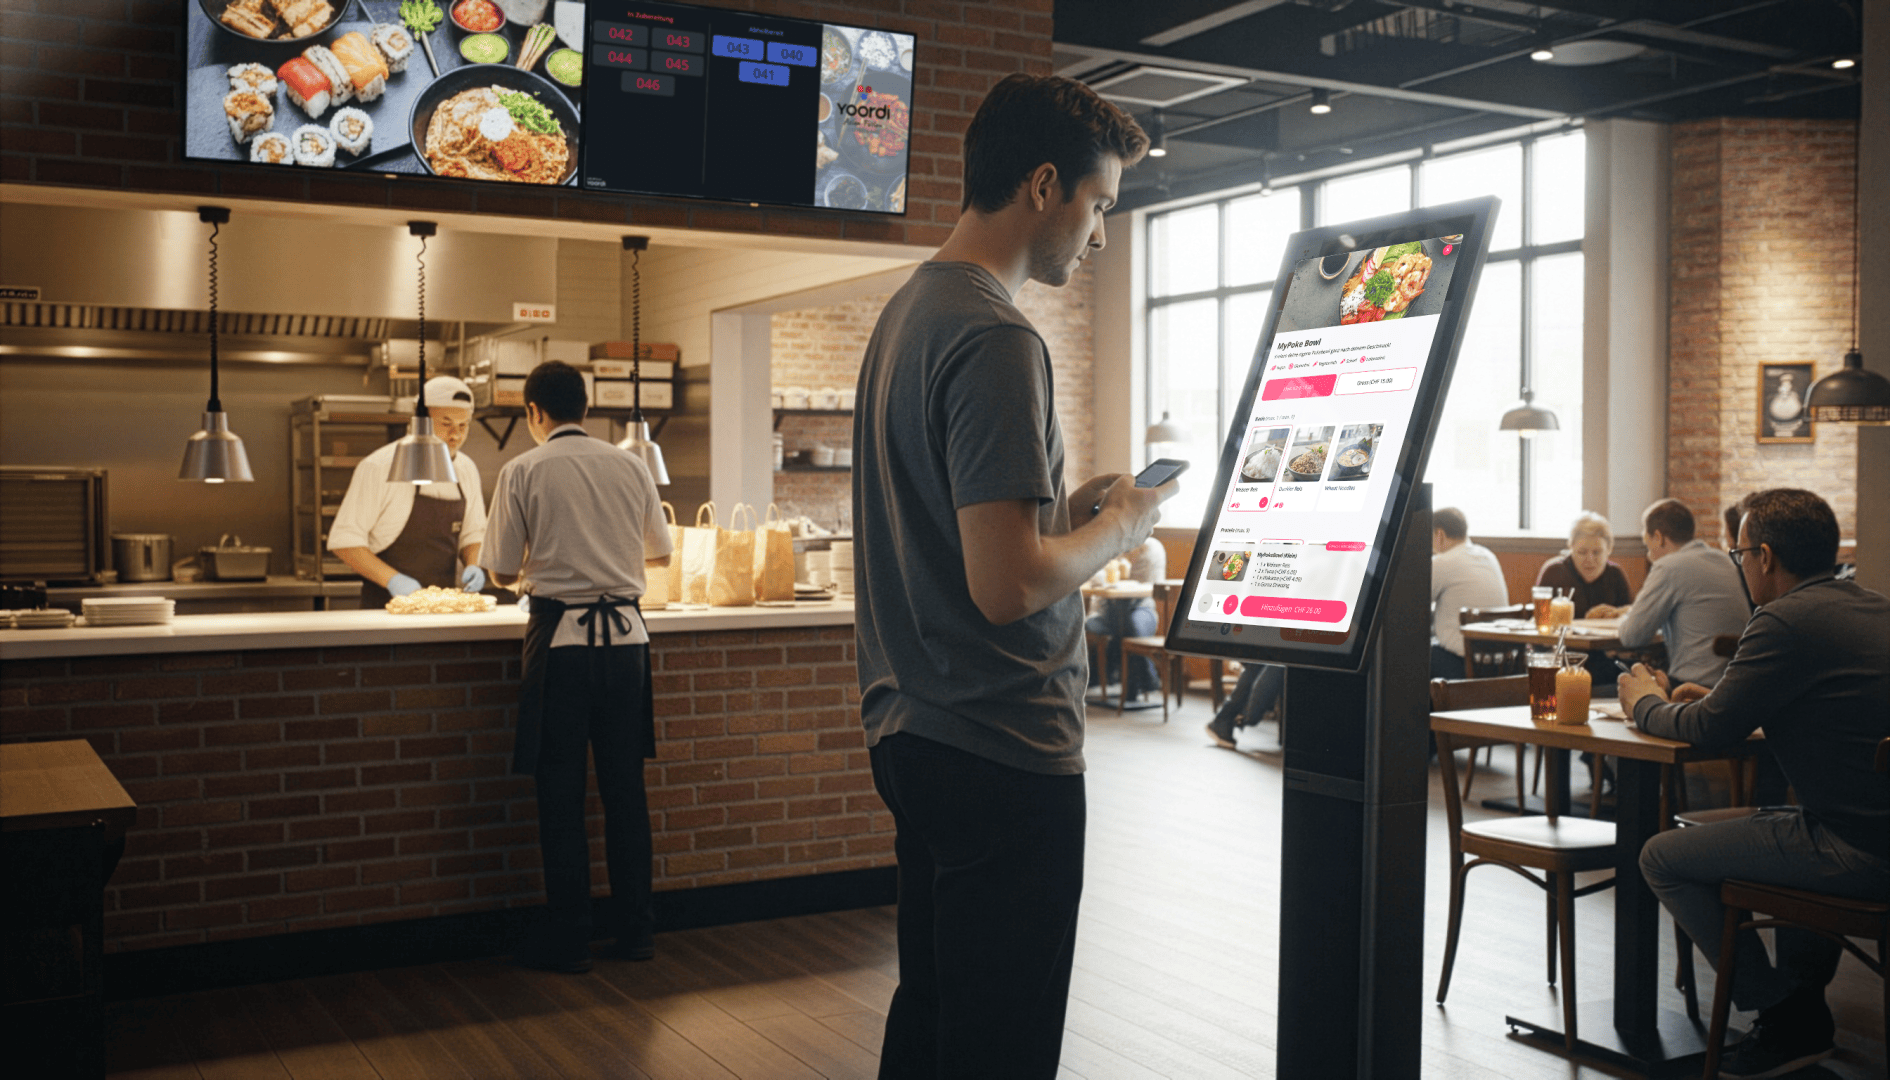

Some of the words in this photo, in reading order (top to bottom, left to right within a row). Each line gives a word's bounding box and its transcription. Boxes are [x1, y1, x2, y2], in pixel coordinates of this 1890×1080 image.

[608, 27, 633, 40] 042
[666, 34, 690, 48] 043
[727, 42, 749, 55] 043
[781, 49, 803, 61] 040
[608, 51, 632, 64] 044
[666, 58, 689, 71] 045
[753, 68, 774, 80] 041
[636, 78, 660, 91] 046
[1277, 341, 1303, 351] MyPoke
[1304, 338, 1321, 347] Bowl
[1261, 603, 1292, 613] Hinzufügen
[1306, 606, 1321, 614] 26.00
